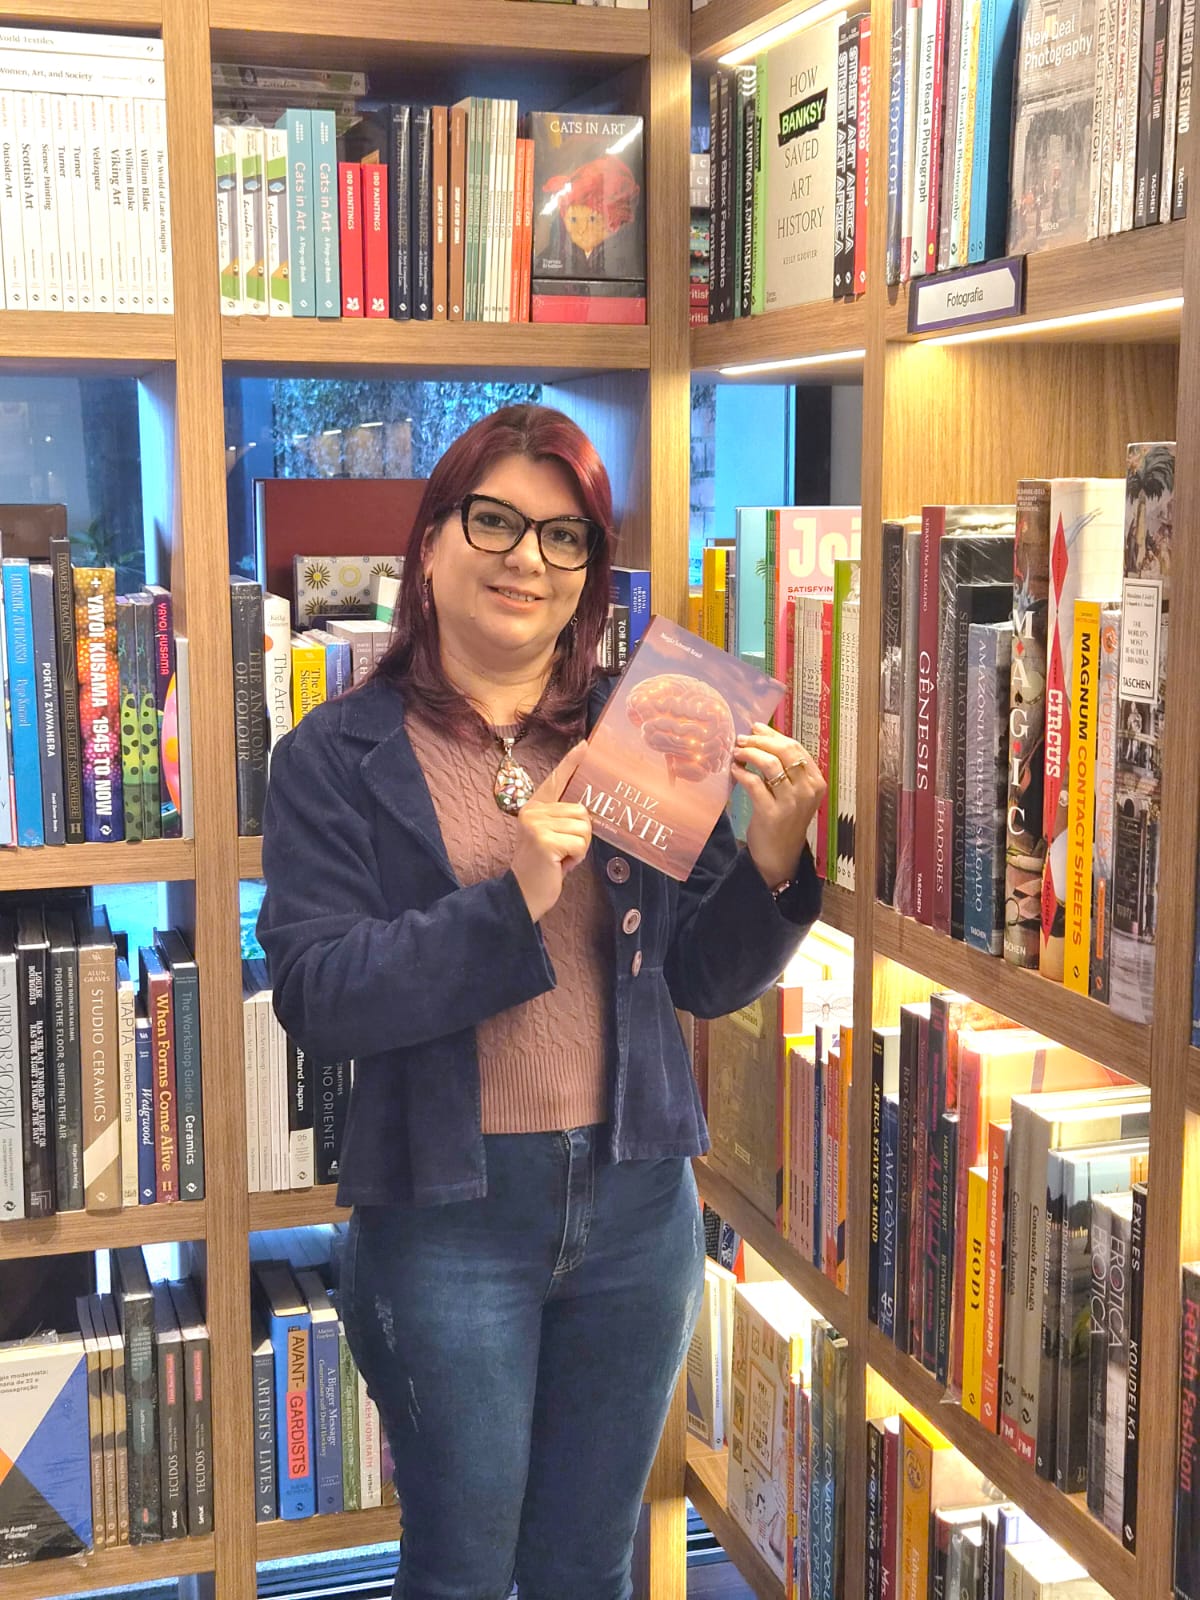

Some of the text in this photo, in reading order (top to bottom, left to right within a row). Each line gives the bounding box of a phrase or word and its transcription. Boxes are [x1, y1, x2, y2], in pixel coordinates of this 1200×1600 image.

[1024, 33, 1094, 72] Photography
[1025, 13, 1076, 51] New Deal
[31, 70, 93, 82] Art, and Society
[789, 65, 818, 98] HOW
[889, 26, 903, 196] FOTOGRAFIA
[1093, 8, 1107, 163] HELMUT NEWTON
[1178, 66, 1192, 134] TESTINO
[549, 119, 626, 136] CATS IN ART
[779, 97, 825, 136] BANKSY
[784, 138, 820, 169] SAVED
[845, 46, 859, 255] STREET ART AFRICA
[859, 90, 867, 151] TATTOO
[919, 34, 935, 204] How to Read Photograph
[3, 142, 13, 199] Outsider Art
[22, 143, 34, 210] Scottish Art
[44, 176, 52, 211] Painting
[58, 146, 66, 178] Turner
[73, 146, 81, 179] Turner
[109, 149, 121, 206] Viking Art
[125, 148, 135, 212] William Blake
[141, 149, 150, 212] William Blake
[295, 162, 306, 232] Cats in Art
[320, 163, 332, 233] Cats in Art
[720, 159, 728, 208] Black
[789, 175, 812, 202] ART
[834, 129, 847, 257] ART AFRICA
[1177, 166, 1185, 209] TASCHEN
[777, 205, 825, 240] HISTORY
[946, 287, 985, 308] Fotografia
[60, 555, 72, 643] TAVARES STRACHAN
[87, 594, 108, 708] YAYOI KUSAMA
[157, 602, 170, 676] YAYOI KUSAMA
[43, 662, 56, 758] PORTIA ZVAVAHERA
[236, 661, 250, 762] OF COLOUR
[249, 649, 265, 774] THE ANATOMY
[274, 653, 289, 732] The Art of
[311, 668, 321, 688] The
[1122, 676, 1152, 690] TASCHEN
[65, 690, 79, 818] THERE LIGHT SOMEWHERE
[917, 650, 935, 791] GÊNESIS
[1046, 688, 1063, 779] CIRCUS
[92, 715, 113, 817] 1945 TO NOW
[614, 780, 660, 814] FELIZ
[956, 722, 967, 818] SALGADO
[1073, 632, 1091, 947] MAGNUM CONTACT SHEETS
[578, 783, 674, 852] MENTE
[975, 749, 984, 913] TOUCH SALGADO
[28, 965, 36, 1006] BOURGEOIS
[35, 971, 43, 998] LOUISE
[84, 976, 111, 984] GRAVES
[54, 967, 67, 1138] PROBING THE FLOOR, SNIFFING THE AIR
[91, 988, 106, 1122] STUDIO CERAMICS
[120, 1000, 134, 1122] TAPTA Flexible Forms
[156, 993, 174, 1172] When Forms Come Alive
[181, 991, 197, 1165] The Workshop Guide Ceramics
[139, 1088, 153, 1145] Wedgwood
[296, 1081, 305, 1112] Japan
[322, 1065, 336, 1151] NO ORIENTE
[871, 1082, 882, 1244] AFRICA STATE OF MIND
[942, 1133, 950, 1174] HARRY
[883, 1142, 896, 1268] AMAZÔNIA
[1010, 1190, 1021, 1248] Consuelo
[970, 1237, 983, 1313] BODY
[987, 1165, 999, 1355] Chronology of Photography
[1028, 1204, 1041, 1312] Consuelo Kanaga
[1043, 1210, 1053, 1295] Dislocations
[1060, 1219, 1070, 1304] Dislocations
[1090, 1226, 1107, 1335] EROTICA
[1108, 1235, 1126, 1348] EROTICA
[1127, 1201, 1143, 1441] EXILES KOUDELKA
[292, 1335, 305, 1389] AVANT-
[1181, 1298, 1200, 1491] Fetish Fashion
[290, 1395, 306, 1475] GARDISTS
[326, 1367, 338, 1446] A Bigger Message
[167, 1455, 179, 1499] TECIDOS
[195, 1451, 206, 1495] TECIDOS
[259, 1450, 272, 1494] LIVES
[812, 1423, 821, 1525] LEONARDO
[824, 1442, 833, 1543] LEONARDO
[869, 1466, 878, 1549] MORIYAMA
